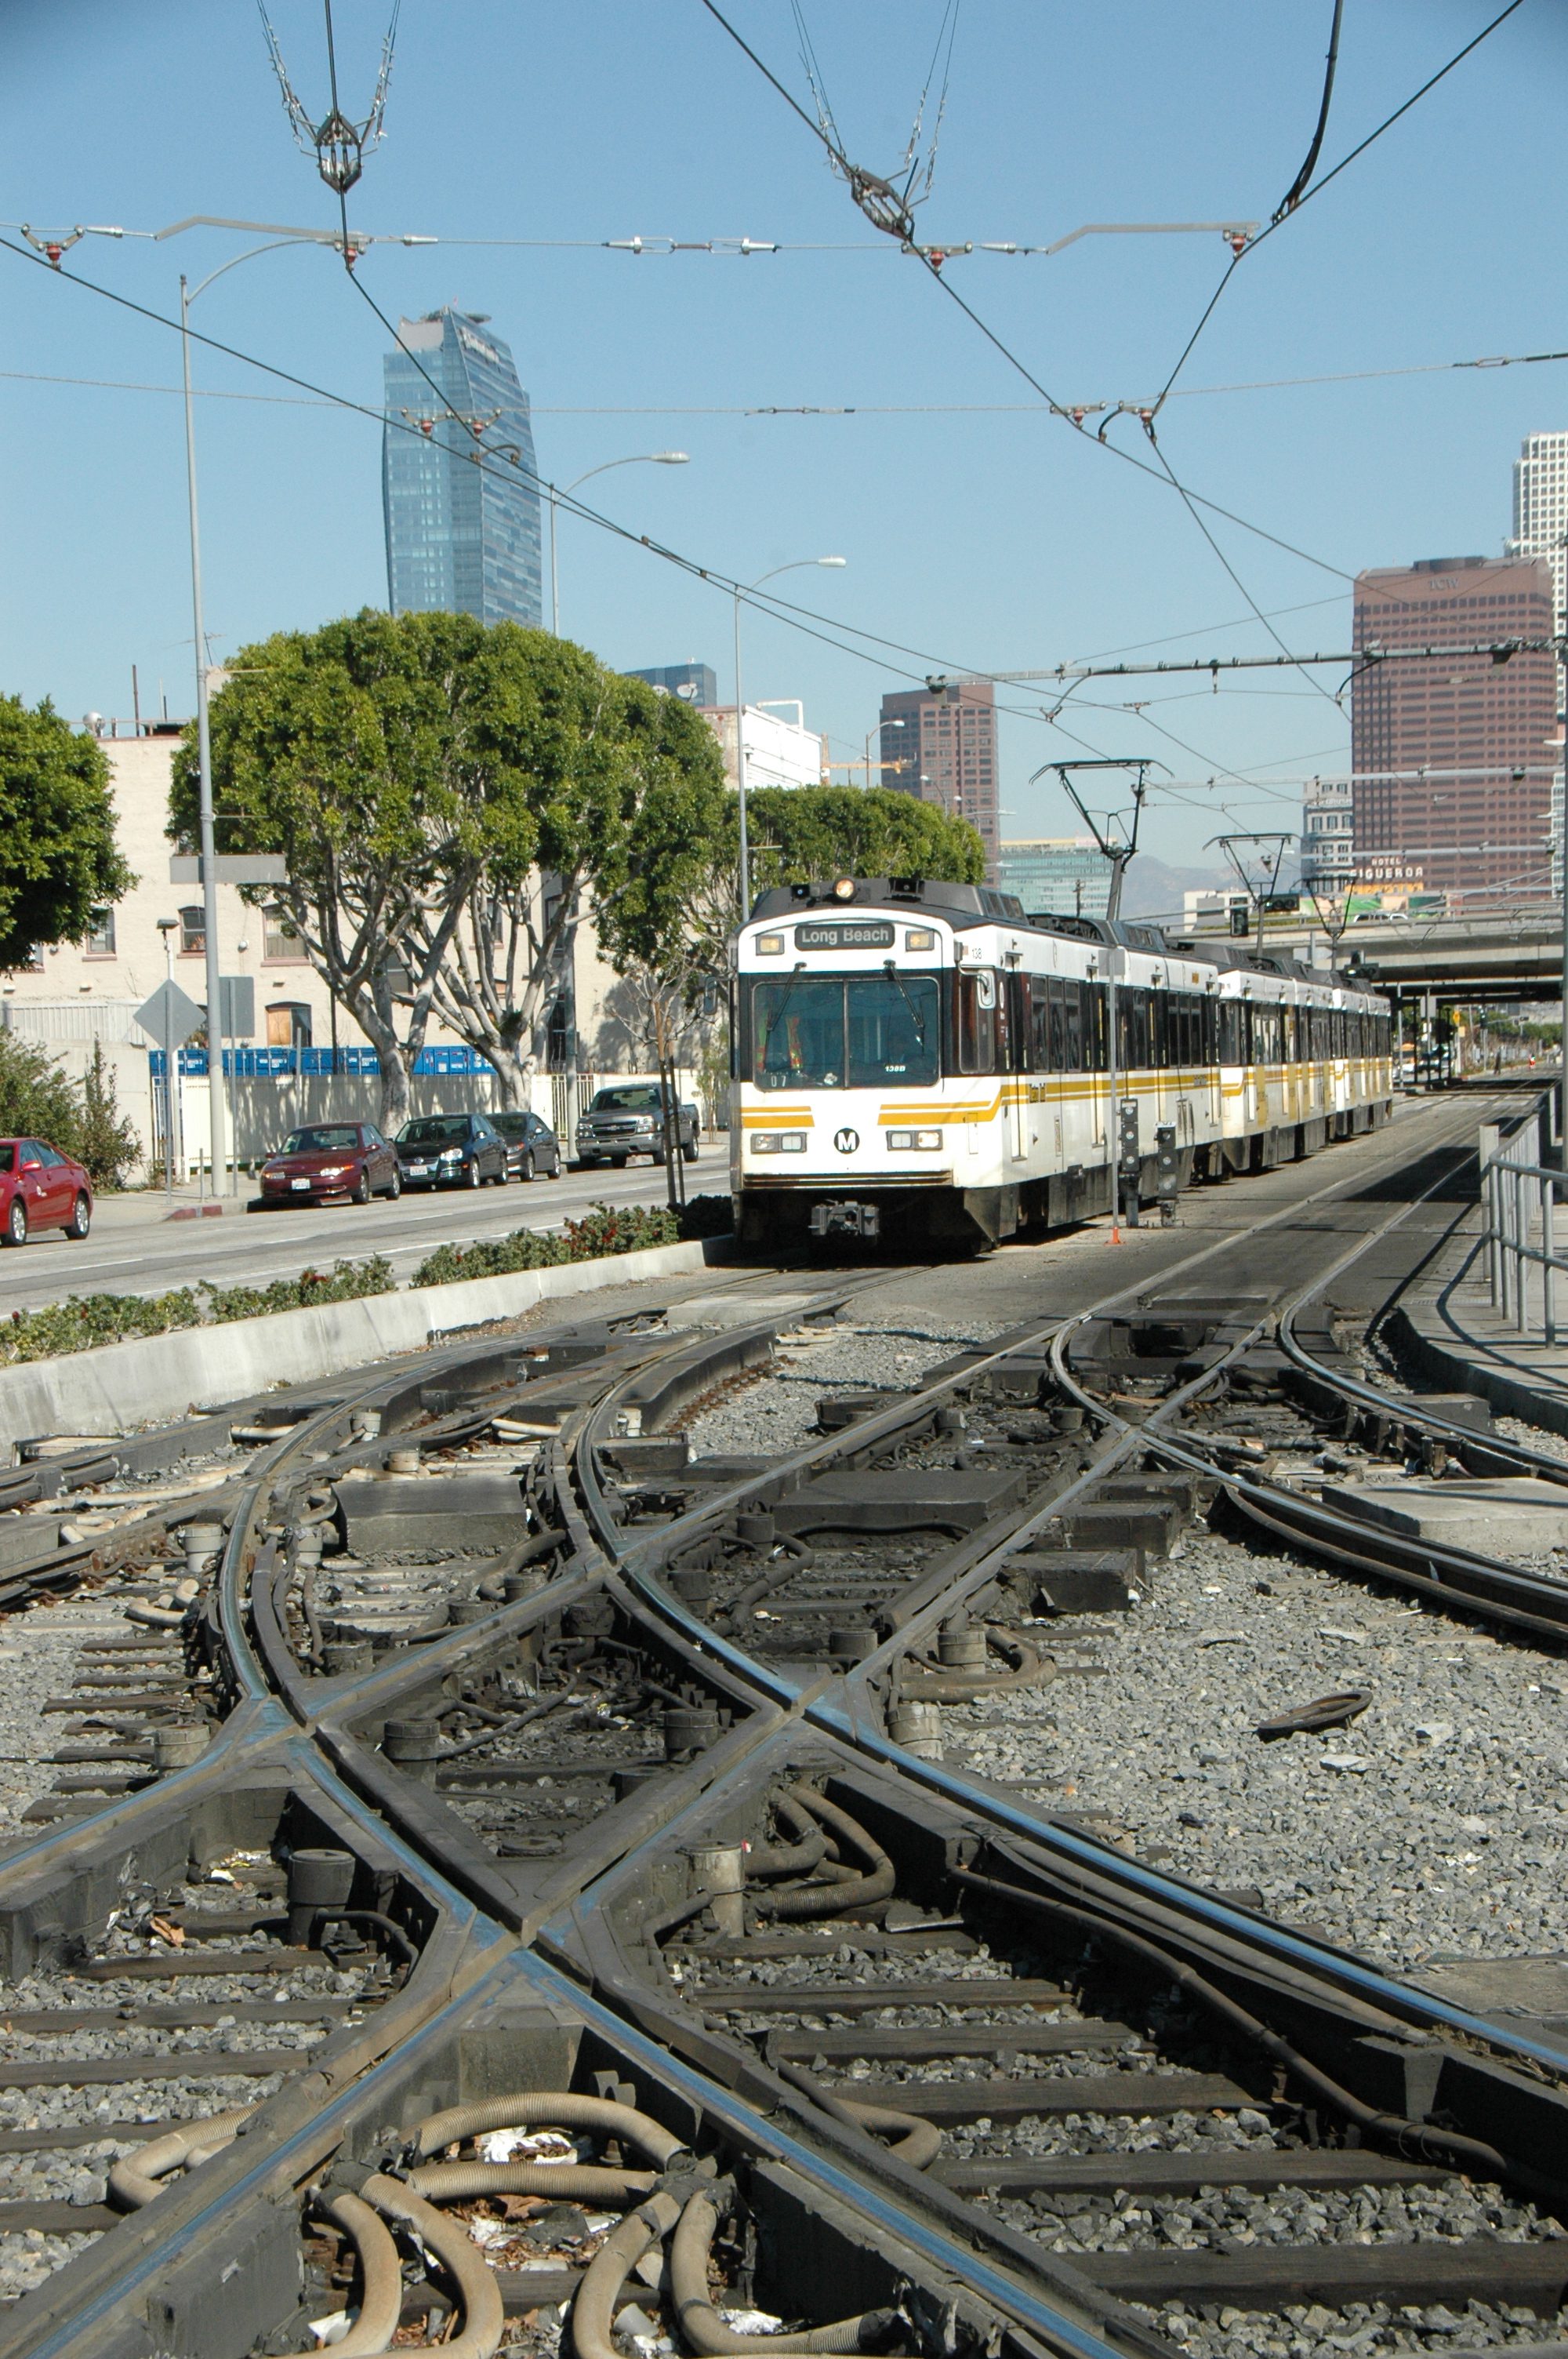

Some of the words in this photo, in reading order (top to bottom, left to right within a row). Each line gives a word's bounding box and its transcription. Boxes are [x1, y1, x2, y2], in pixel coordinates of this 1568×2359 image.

[1371, 857, 1402, 866] HOTEL
[802, 930, 838, 945] Long
[843, 928, 888, 942] Beach
[972, 947, 982, 959] 138
[837, 1132, 856, 1150] M
